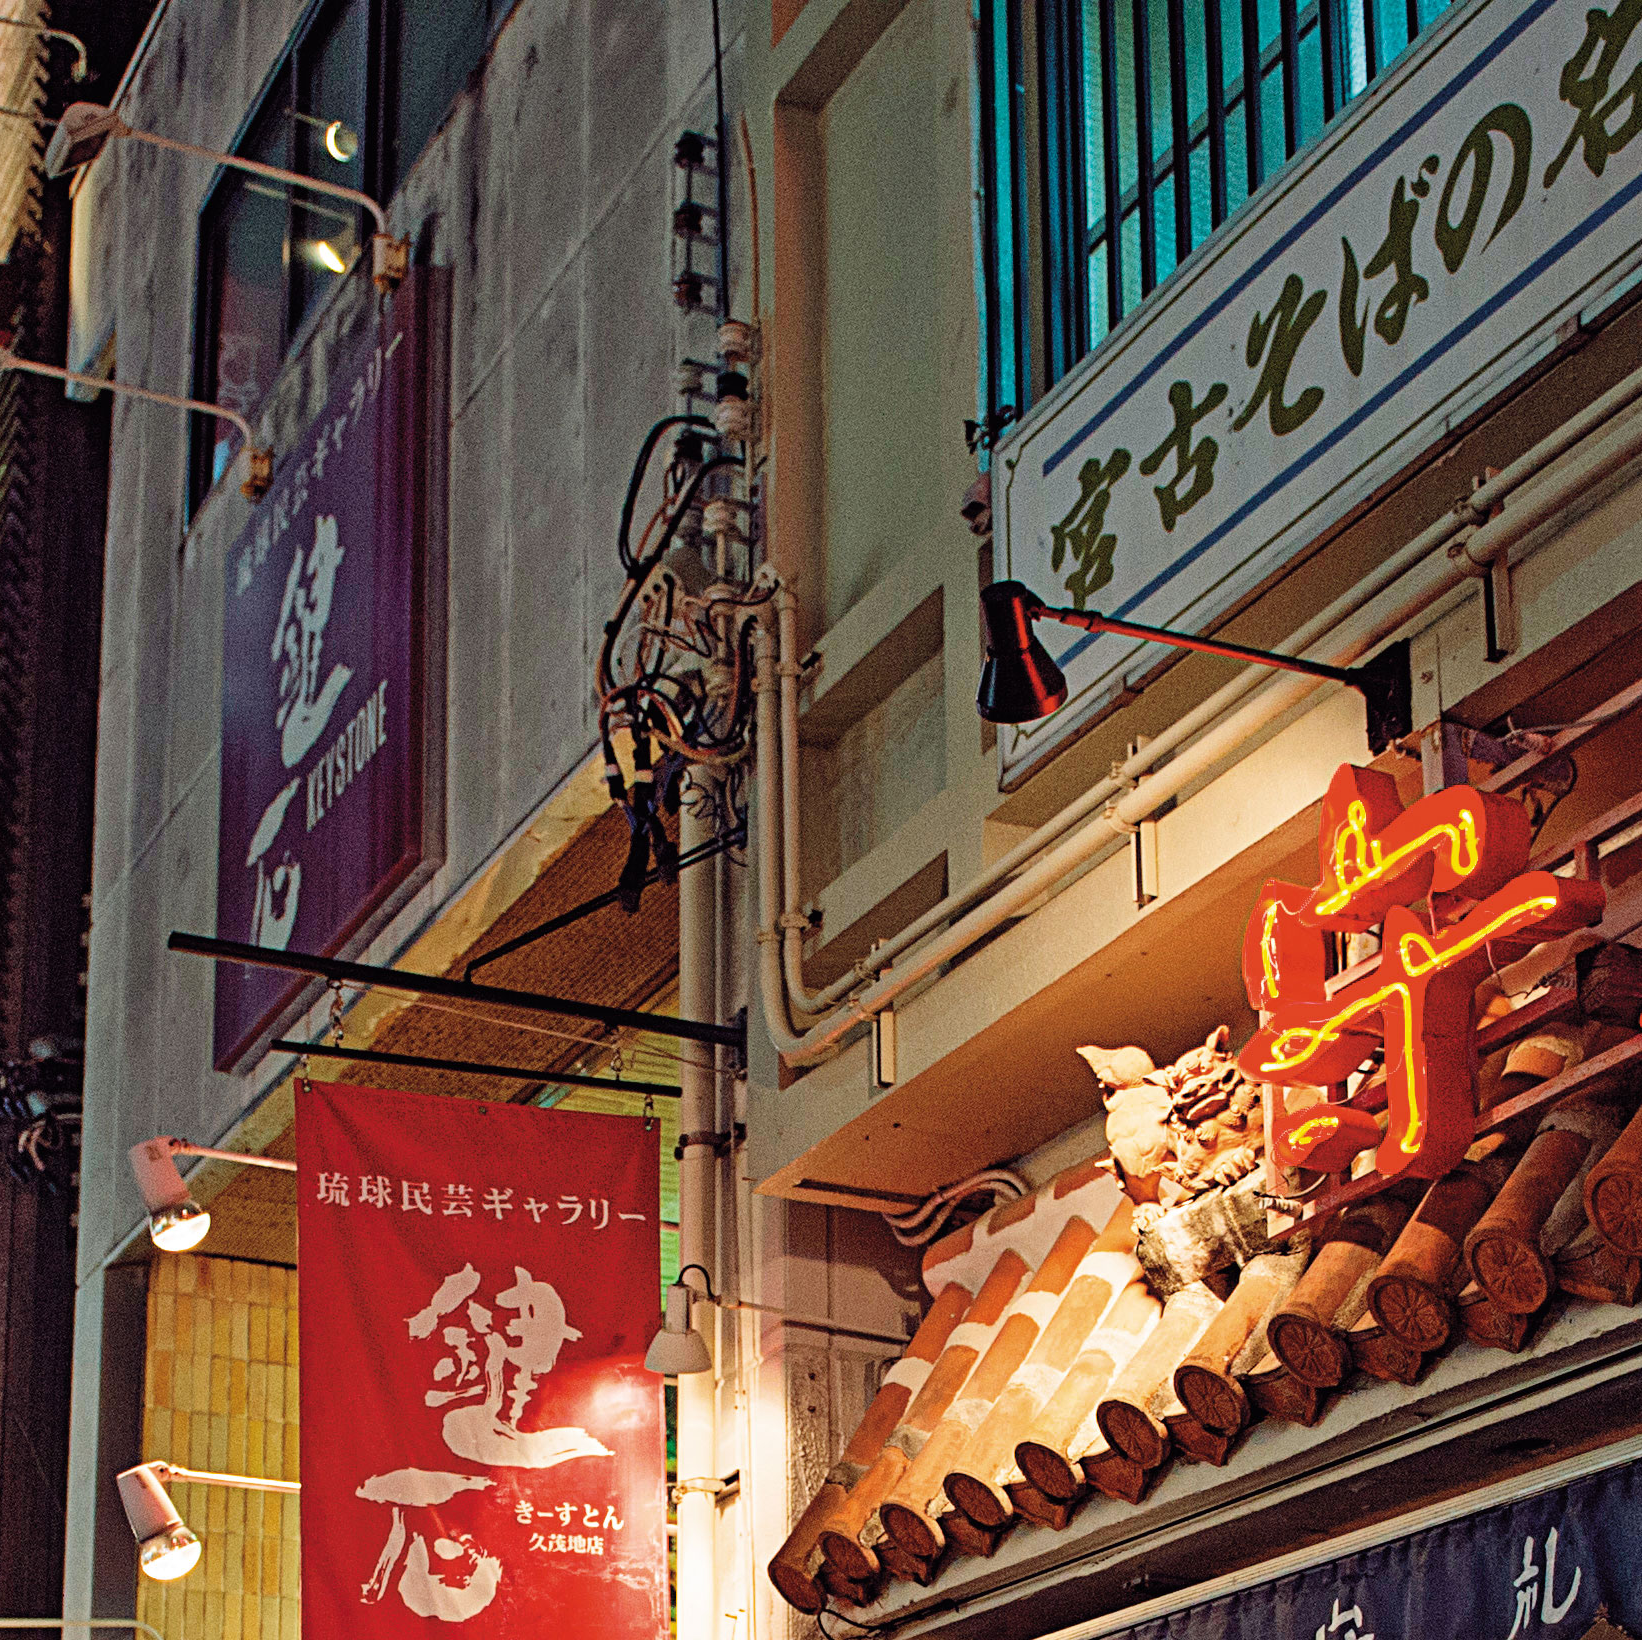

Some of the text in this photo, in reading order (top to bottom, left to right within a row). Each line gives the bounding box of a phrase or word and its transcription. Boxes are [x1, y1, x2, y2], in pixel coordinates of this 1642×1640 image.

[306, 679, 389, 832] KEYSTONE
[315, 1170, 647, 1232] 琉球民芸ギャラリー
[356, 1261, 616, 1624] 鍵石
[514, 1500, 625, 1532] きーすとん
[528, 1532, 605, 1557] 久茂地店
